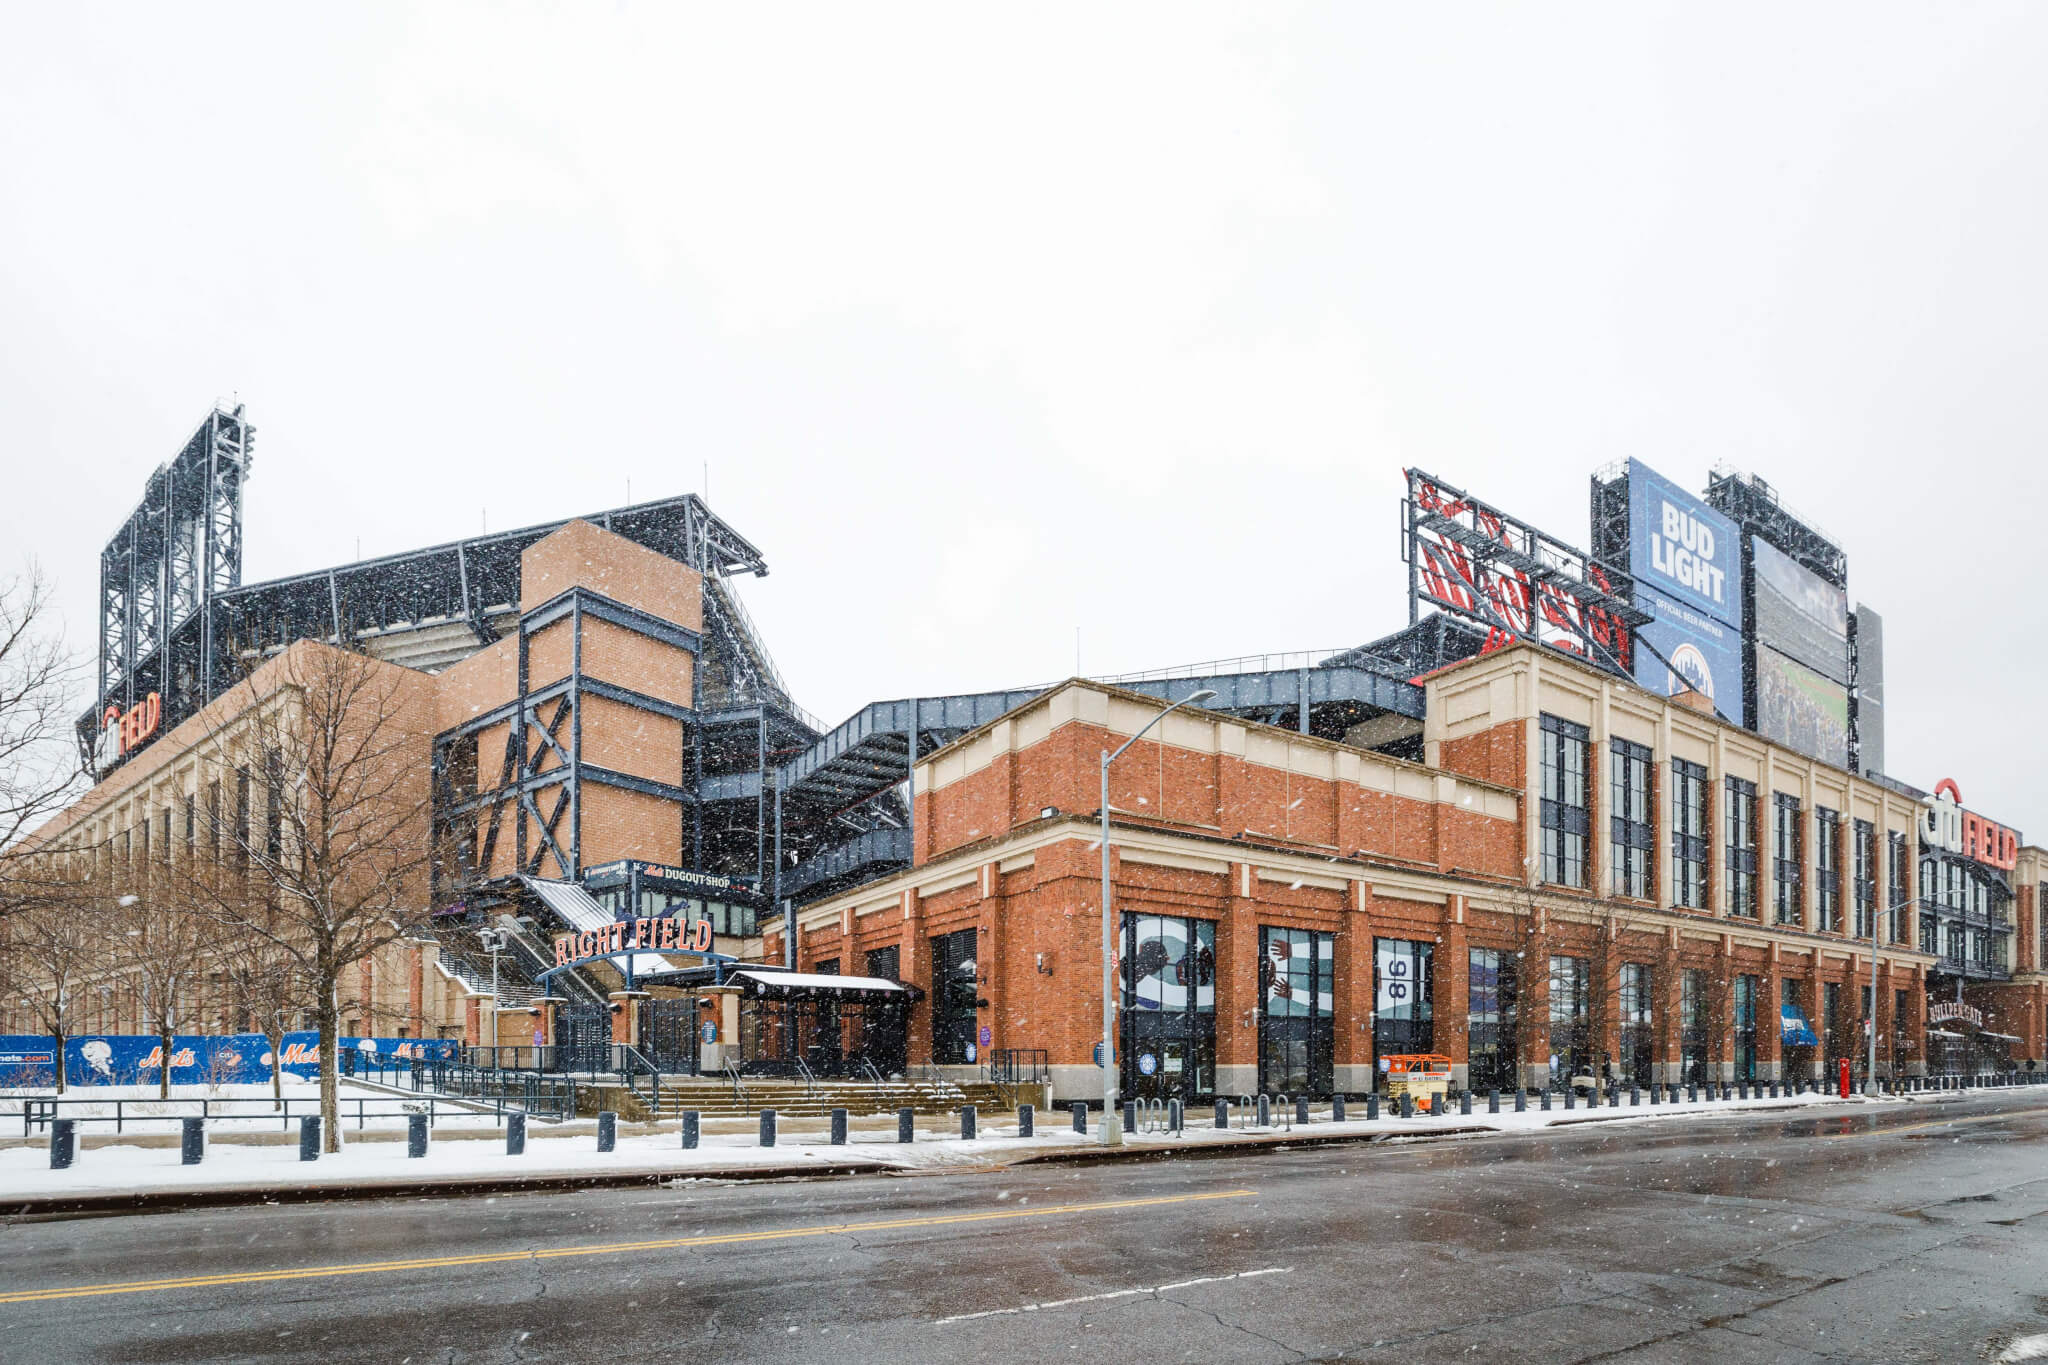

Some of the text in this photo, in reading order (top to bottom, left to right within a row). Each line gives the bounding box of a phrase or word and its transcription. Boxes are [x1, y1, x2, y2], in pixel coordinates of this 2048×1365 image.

[1662, 500, 1715, 561] BUD
[1652, 531, 1725, 603] LIGHT
[1656, 598, 1682, 619] OFFICIAL
[1683, 611, 1698, 627] BEER
[119, 691, 161, 756] FIELD
[1962, 810, 2019, 871] FIELD
[665, 868, 706, 886] DUGOUT
[705, 875, 731, 889] SHOP
[554, 917, 713, 967] RIGHT FIELD
[1929, 1002, 1983, 1028] BULLPEN GATE
